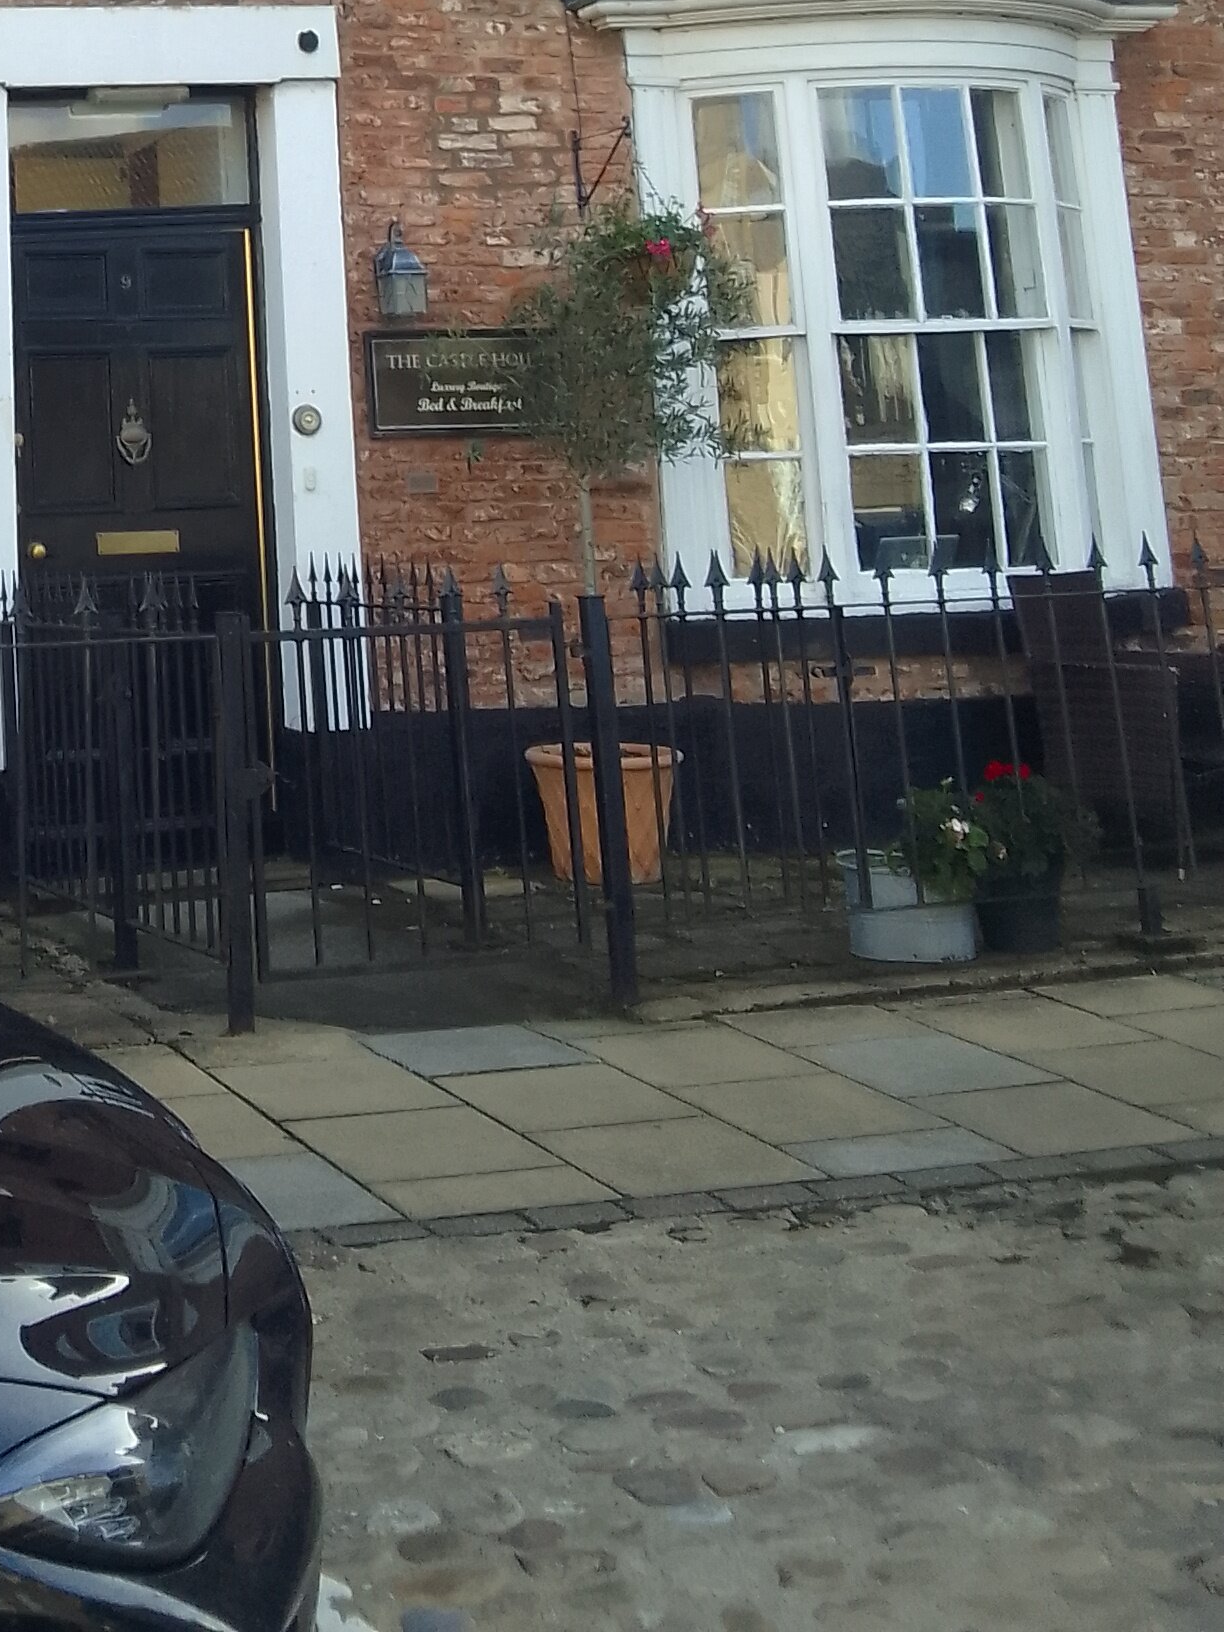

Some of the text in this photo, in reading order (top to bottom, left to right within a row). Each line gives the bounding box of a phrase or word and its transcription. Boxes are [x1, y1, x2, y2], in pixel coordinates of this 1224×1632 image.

[120, 274, 132, 289] 9
[385, 352, 544, 369] THE CASTE HOU
[430, 380, 465, 394] Luxury
[417, 396, 523, 414] Bed & Breakfast
